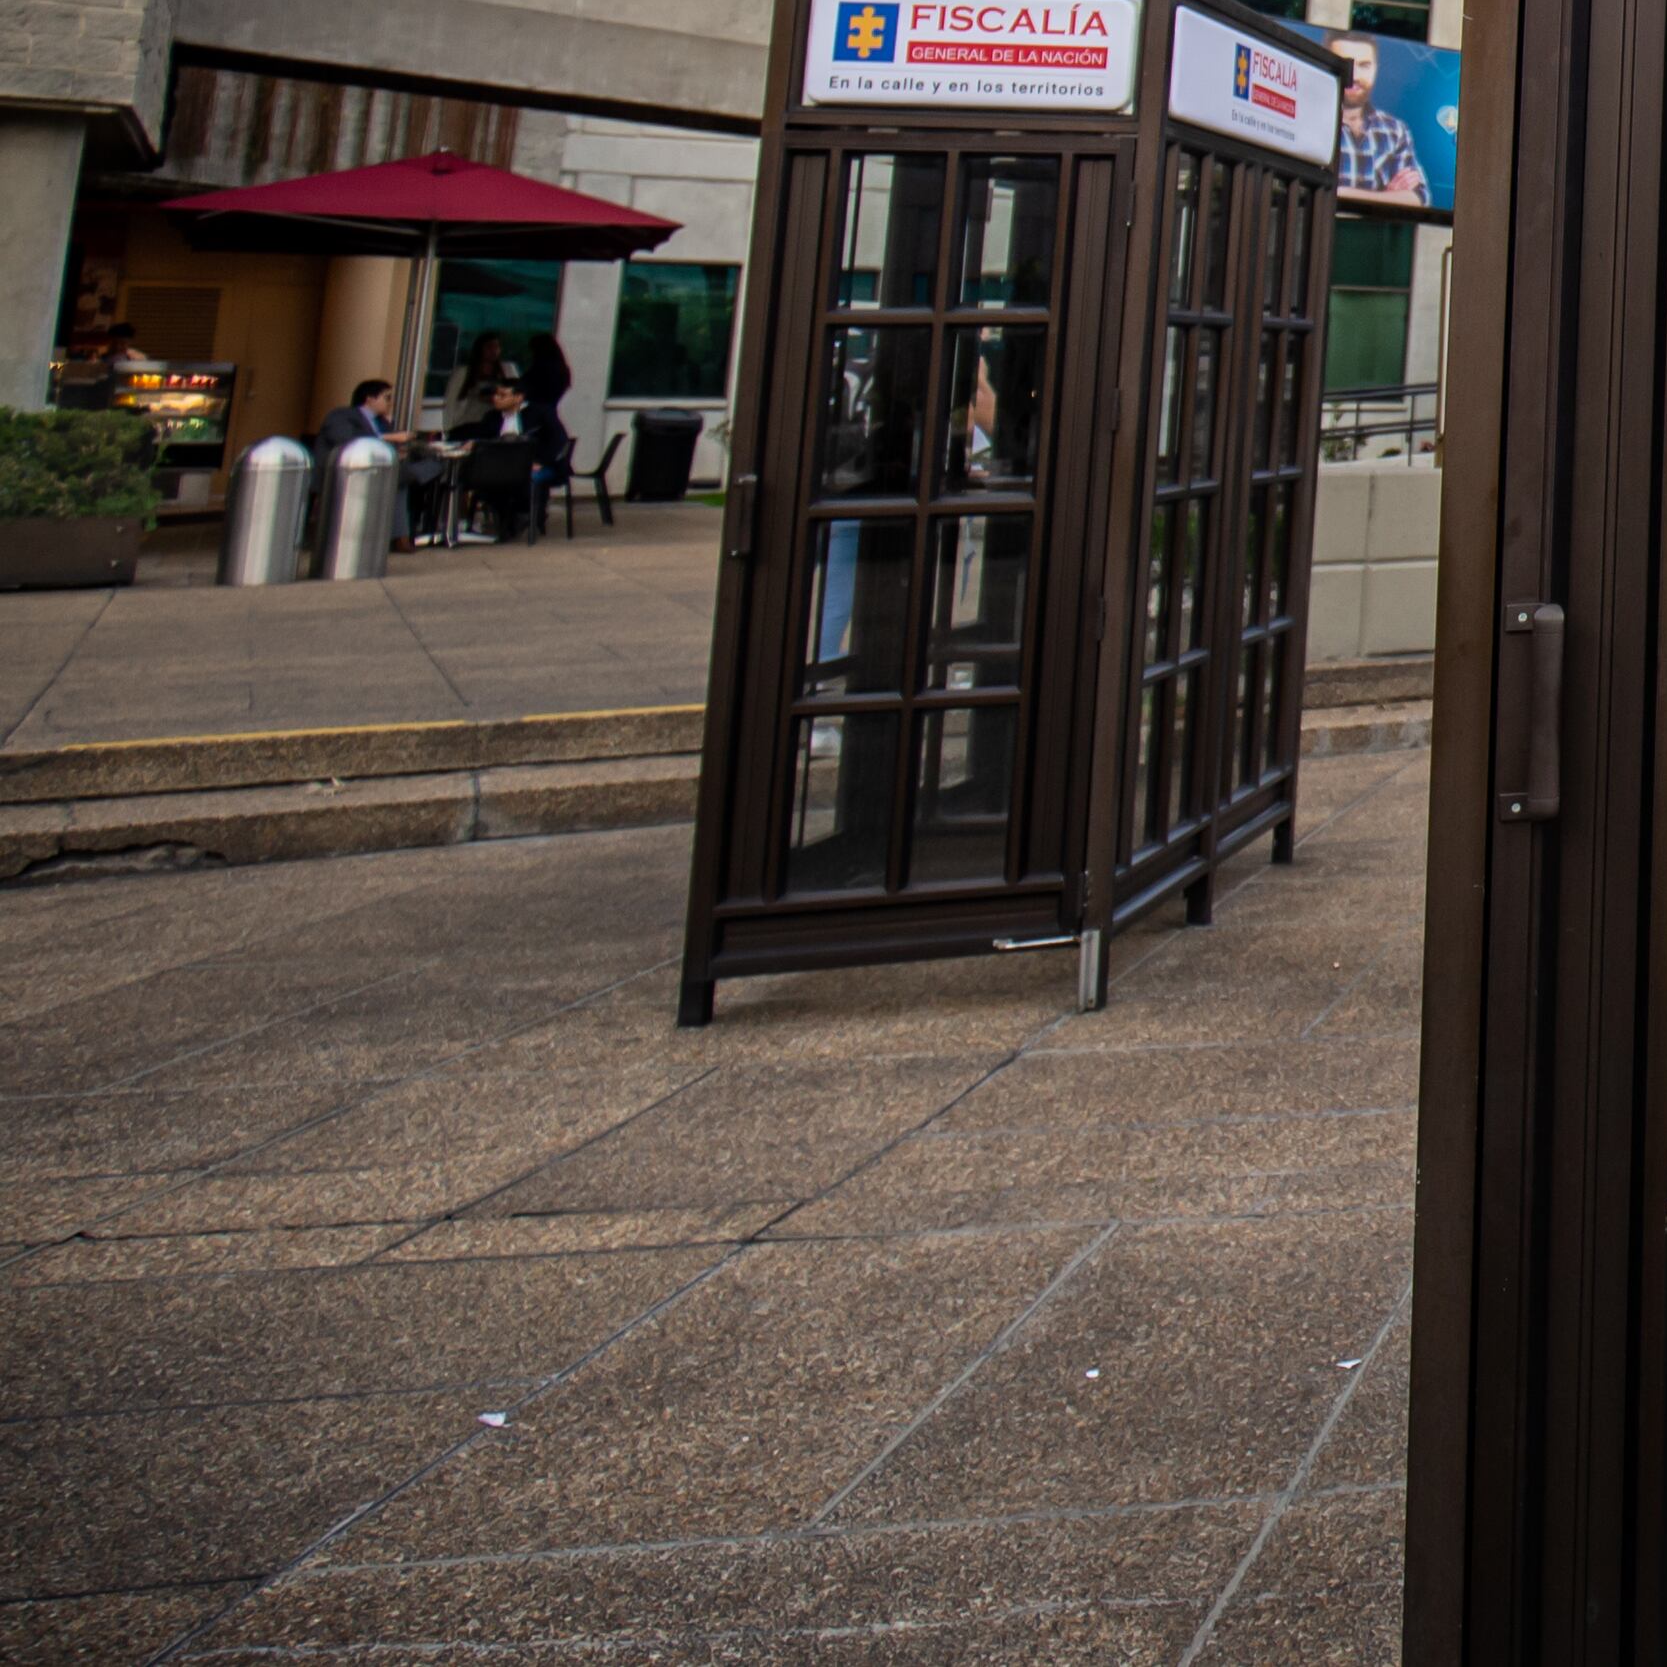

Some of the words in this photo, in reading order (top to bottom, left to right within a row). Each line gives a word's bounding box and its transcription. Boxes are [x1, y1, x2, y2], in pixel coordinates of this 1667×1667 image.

[910, 3, 1108, 37] FISCALÍA
[912, 46, 987, 63] GENERAL
[992, 49, 1013, 63] DE
[1018, 50, 1038, 64] LA
[1041, 48, 1102, 65] NACIÓN
[1252, 51, 1297, 91] FISCALÍA
[829, 76, 849, 89] En
[858, 77, 872, 90] la
[881, 78, 924, 91] calle
[933, 81, 941, 94] y
[949, 81, 968, 93] en
[977, 80, 1003, 94] los
[1011, 82, 1104, 96] territorios
